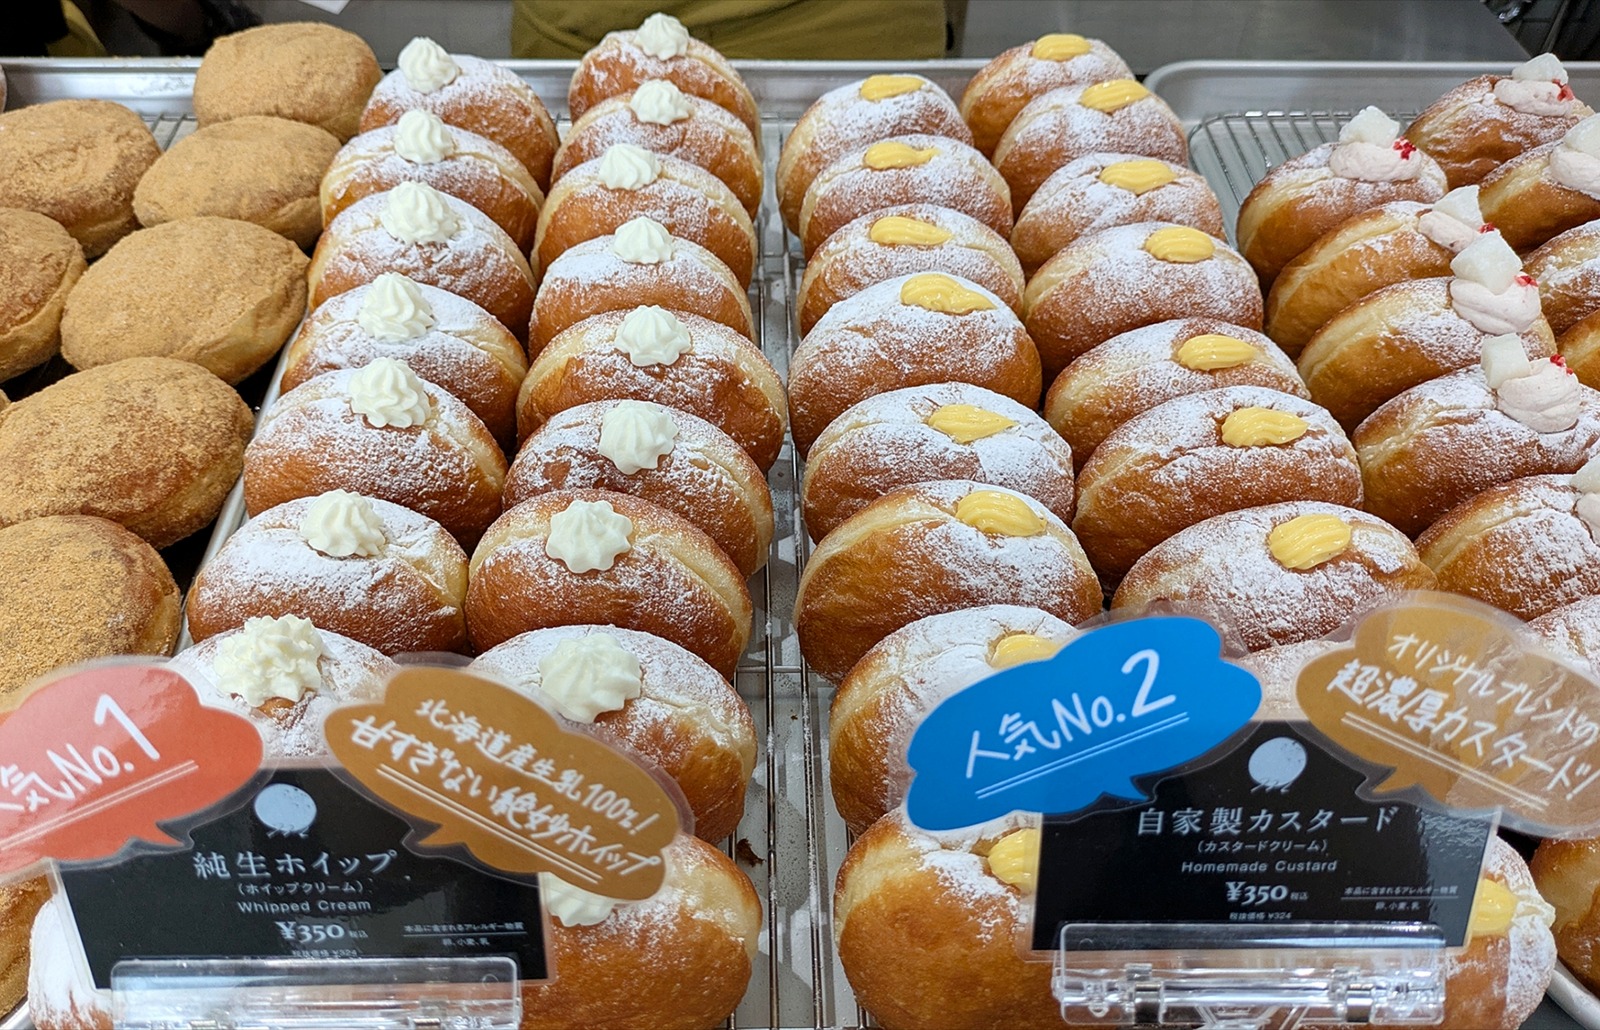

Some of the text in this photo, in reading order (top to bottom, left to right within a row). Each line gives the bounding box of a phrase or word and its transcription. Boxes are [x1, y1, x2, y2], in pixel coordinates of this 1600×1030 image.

[1138, 806, 1399, 836] 自家製カスタード
[192, 849, 398, 879] 純生ホイップ
[1181, 860, 1338, 873] Homemade Custard
[1225, 881, 1288, 906] ¥350
[236, 900, 371, 913] Whipped Cream
[275, 921, 345, 943] ¥350
